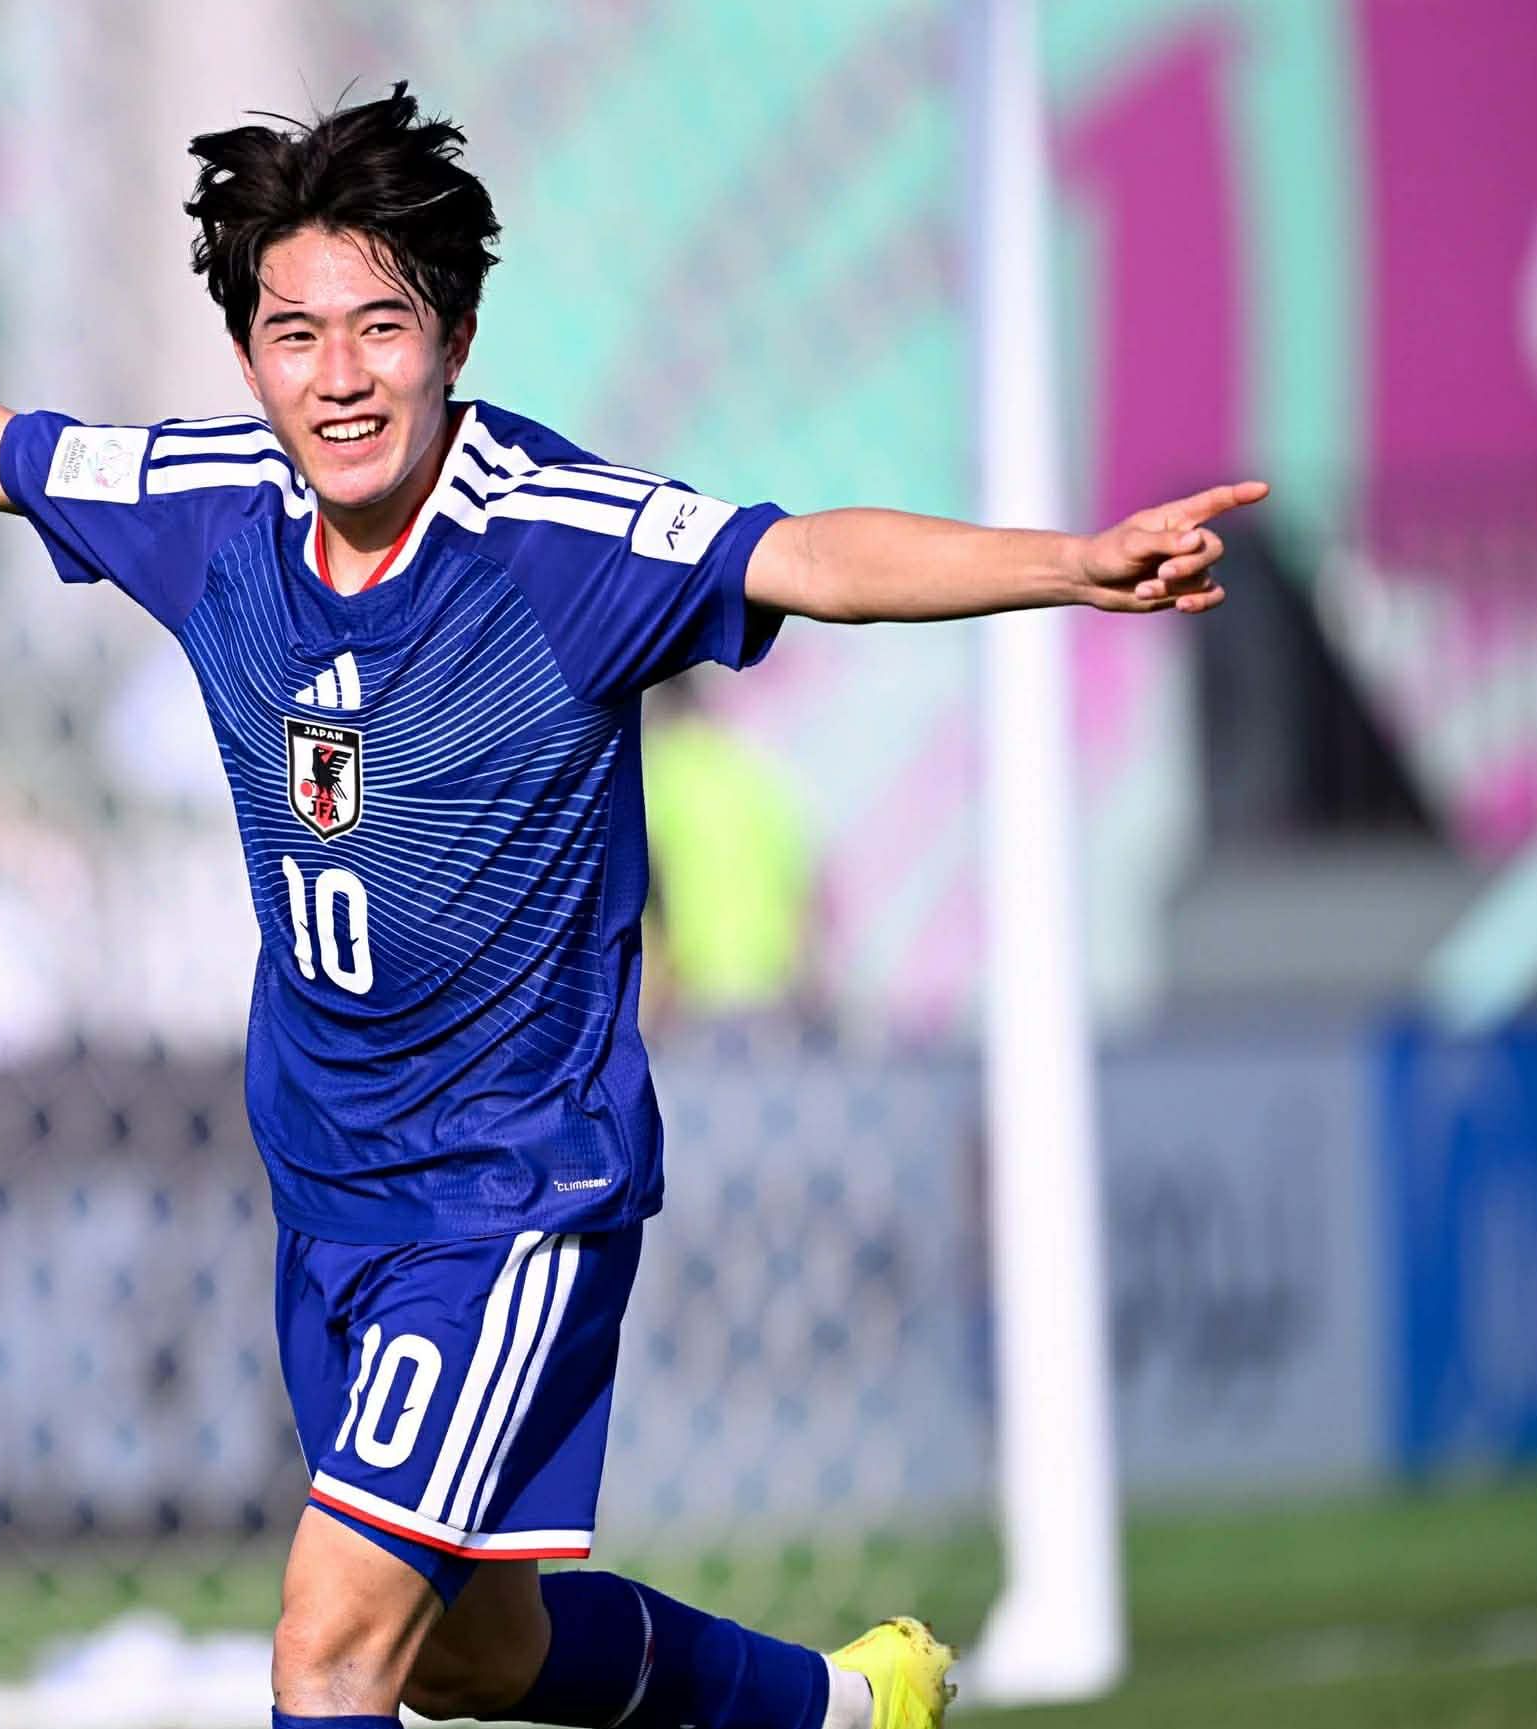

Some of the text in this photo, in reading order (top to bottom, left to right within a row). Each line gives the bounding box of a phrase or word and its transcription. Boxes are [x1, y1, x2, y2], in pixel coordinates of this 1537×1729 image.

[666, 504, 697, 551] AFC
[304, 726, 344, 742] JAPAN
[307, 799, 340, 823] JFA
[282, 855, 374, 995] 10
[557, 1178, 609, 1192] CLIMACOOL
[335, 1323, 442, 1469] 10
